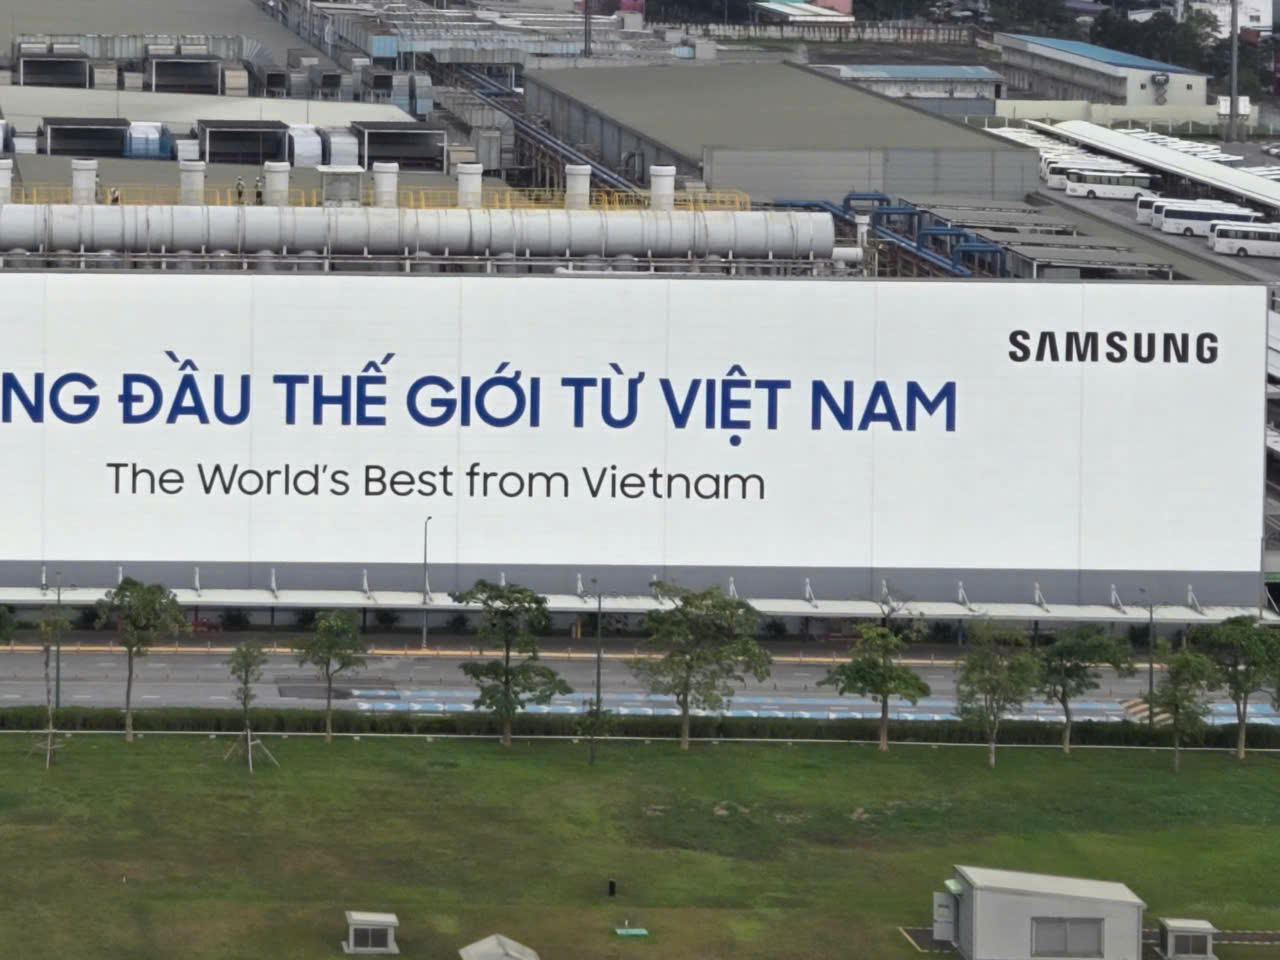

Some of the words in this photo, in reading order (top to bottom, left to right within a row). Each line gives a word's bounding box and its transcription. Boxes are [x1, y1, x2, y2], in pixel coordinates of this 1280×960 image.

[1009, 330, 1219, 364] SAMSUNG
[118, 351, 250, 425] ĐẦU
[273, 353, 394, 425] THẾ
[407, 362, 540, 427] GIỚI
[561, 363, 645, 428] TỪ
[660, 365, 791, 446] VIỆT
[812, 380, 955, 431] NAM
[107, 463, 184, 494] The
[198, 464, 349, 495] World's
[365, 465, 452, 496] Best
[466, 463, 568, 497] from
[583, 465, 764, 499] Vietnam
